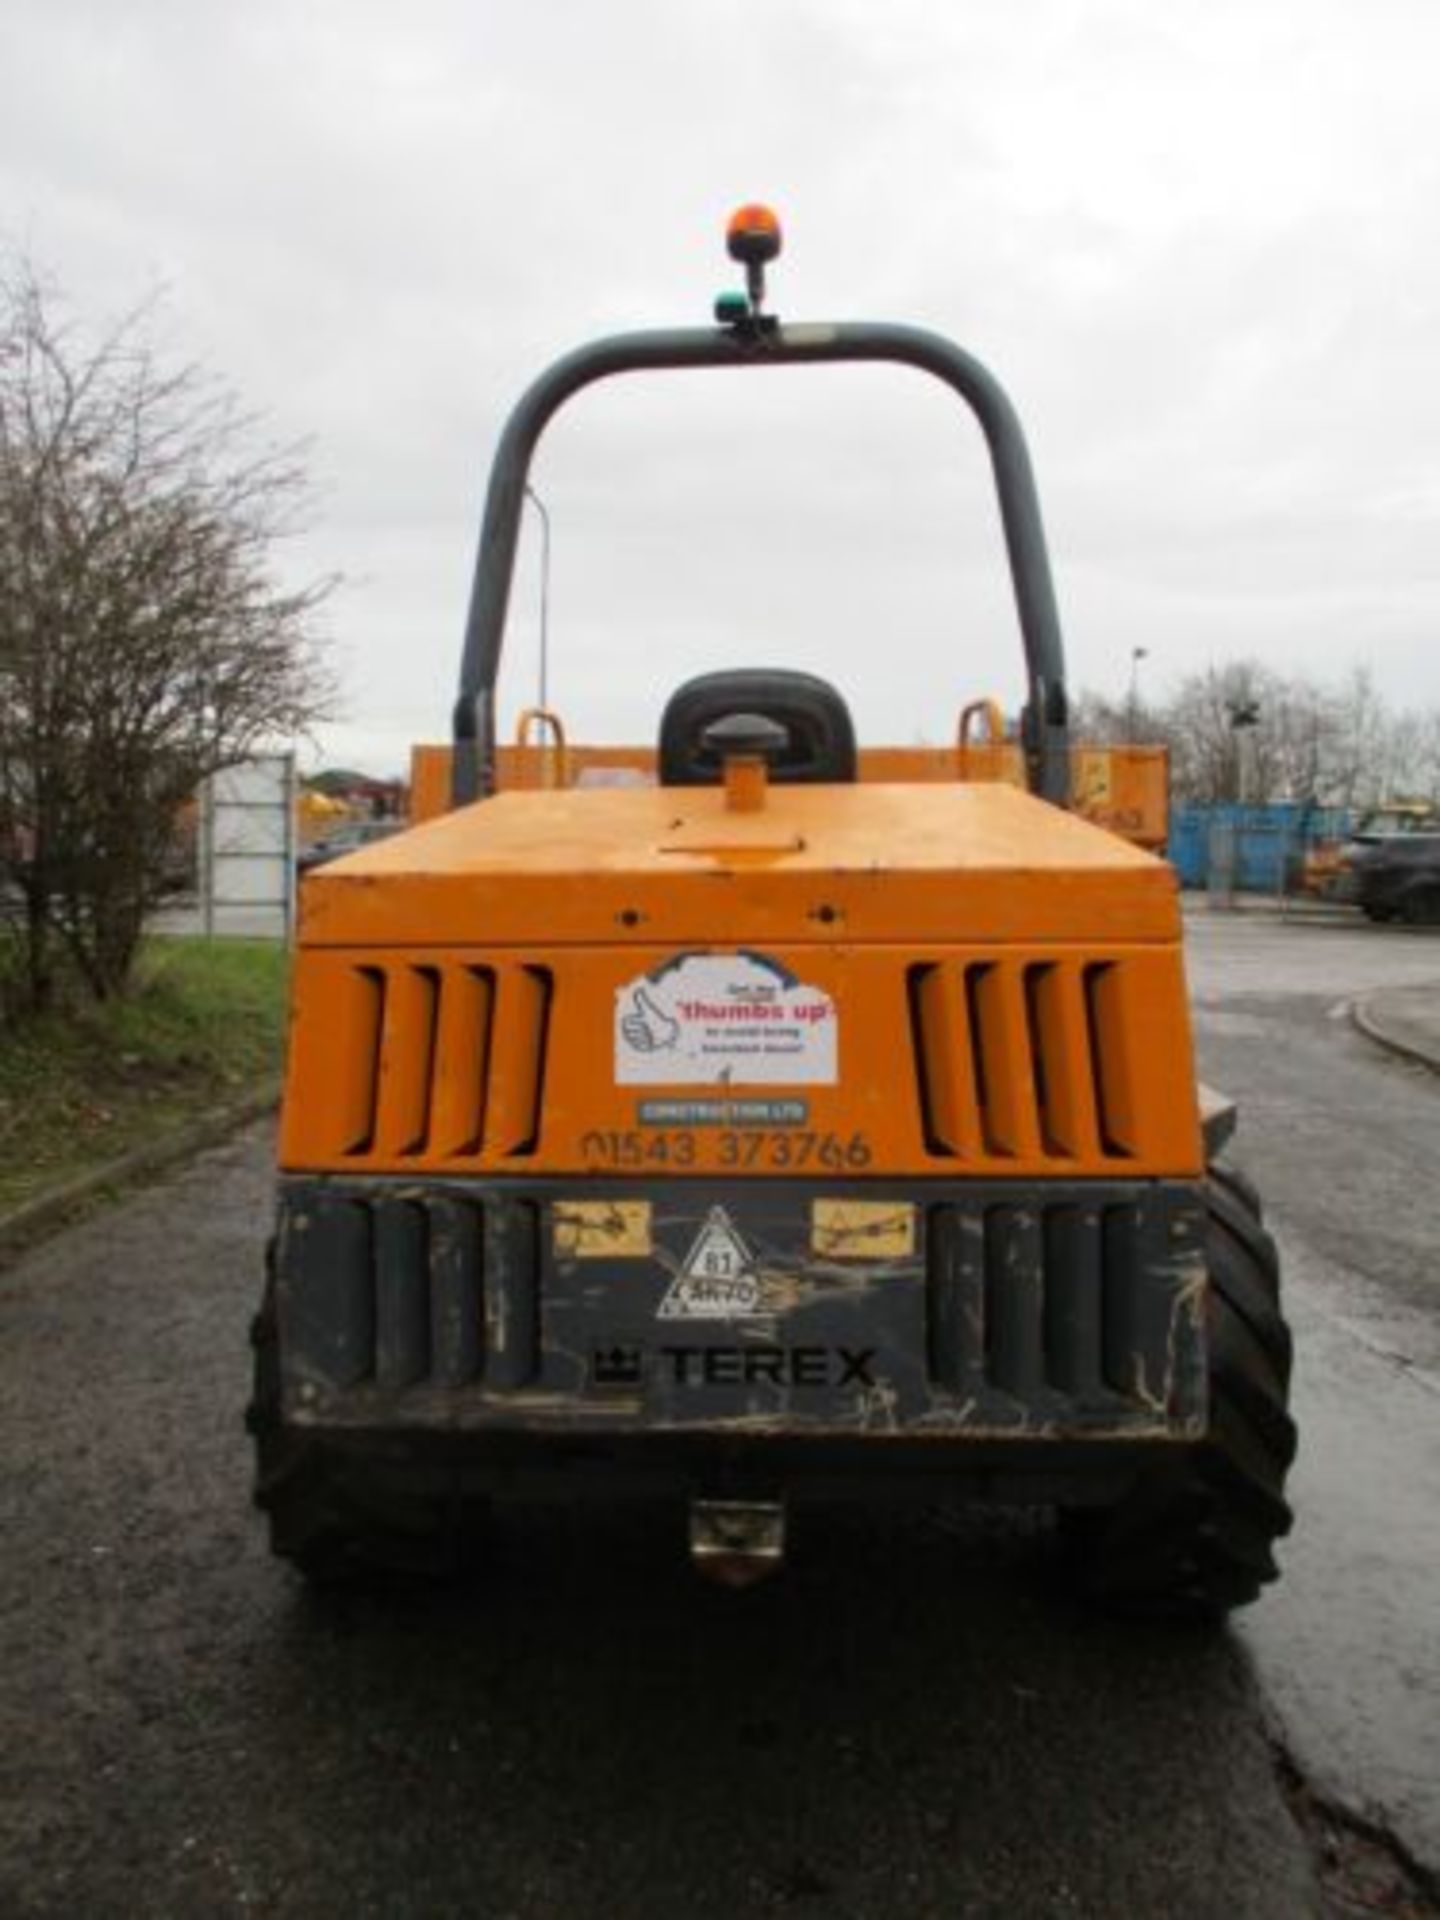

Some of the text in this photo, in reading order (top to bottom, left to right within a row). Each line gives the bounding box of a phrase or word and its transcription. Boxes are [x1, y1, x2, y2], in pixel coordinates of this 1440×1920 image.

[581, 1131, 871, 1167] 01543 373766
[660, 1348, 877, 1387] TEREX
